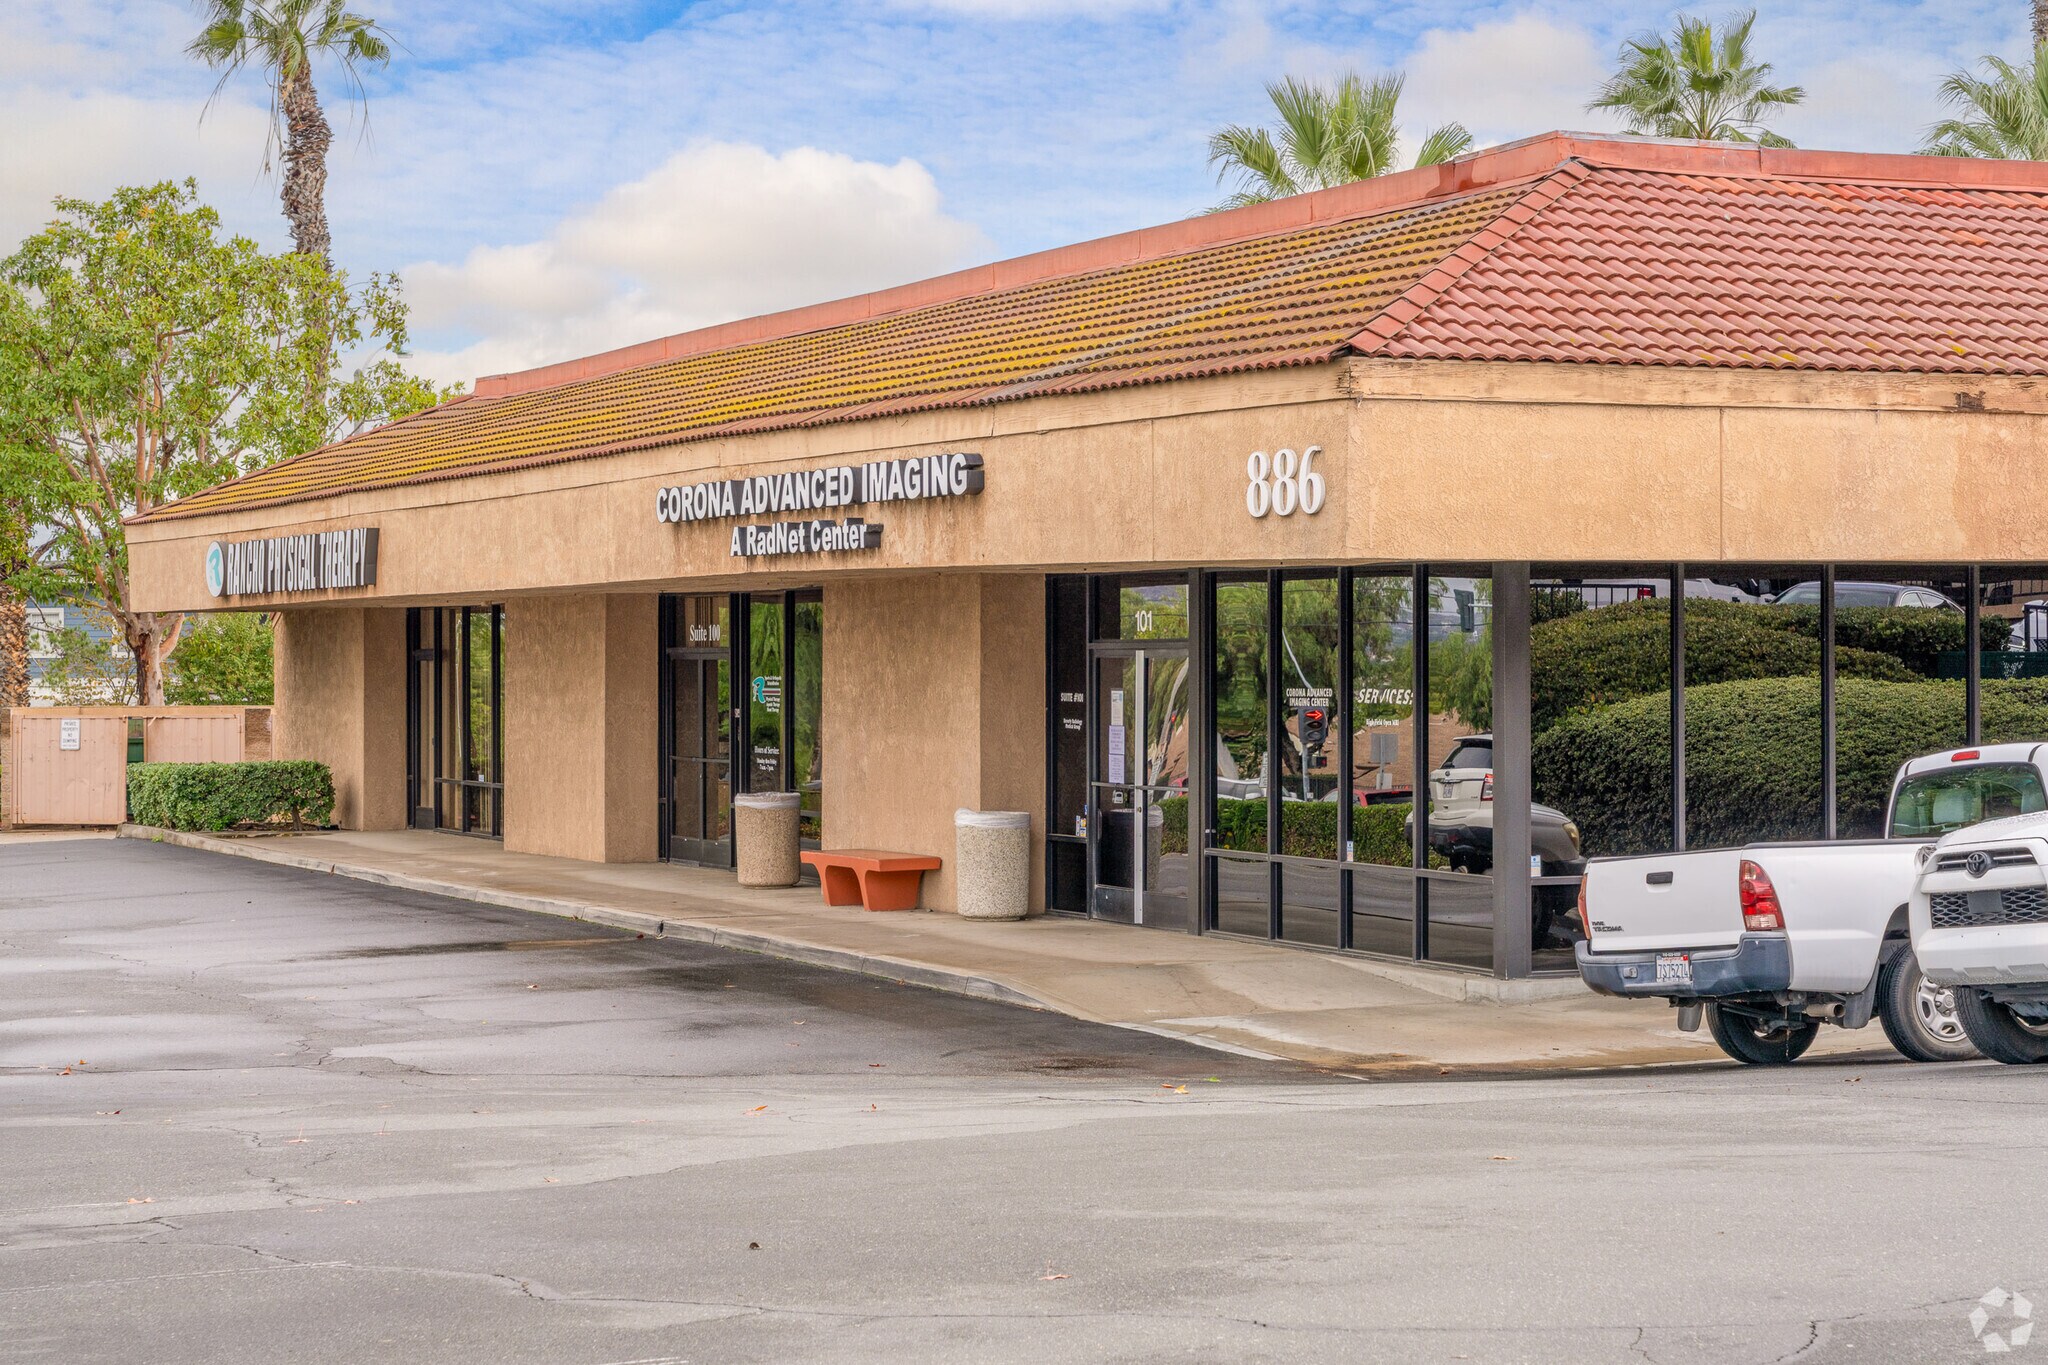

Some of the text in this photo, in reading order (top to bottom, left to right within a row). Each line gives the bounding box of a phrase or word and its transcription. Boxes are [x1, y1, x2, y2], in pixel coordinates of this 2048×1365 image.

[656, 453, 969, 523] CORONA ADVANCED IMAGING
[1246, 445, 1327, 518] 886
[730, 518, 867, 557] A RadNet Center
[227, 539, 265, 596] RANCHO
[267, 534, 316, 593] PHYSICAL
[319, 527, 367, 589] THERAPY
[1135, 610, 1153, 632] 101
[689, 624, 721, 642] Suite 100
[1060, 692, 1073, 702] SUITE
[1286, 688, 1333, 698] CORONA ADVANCED
[1289, 697, 1330, 707] IMAGING CENTER
